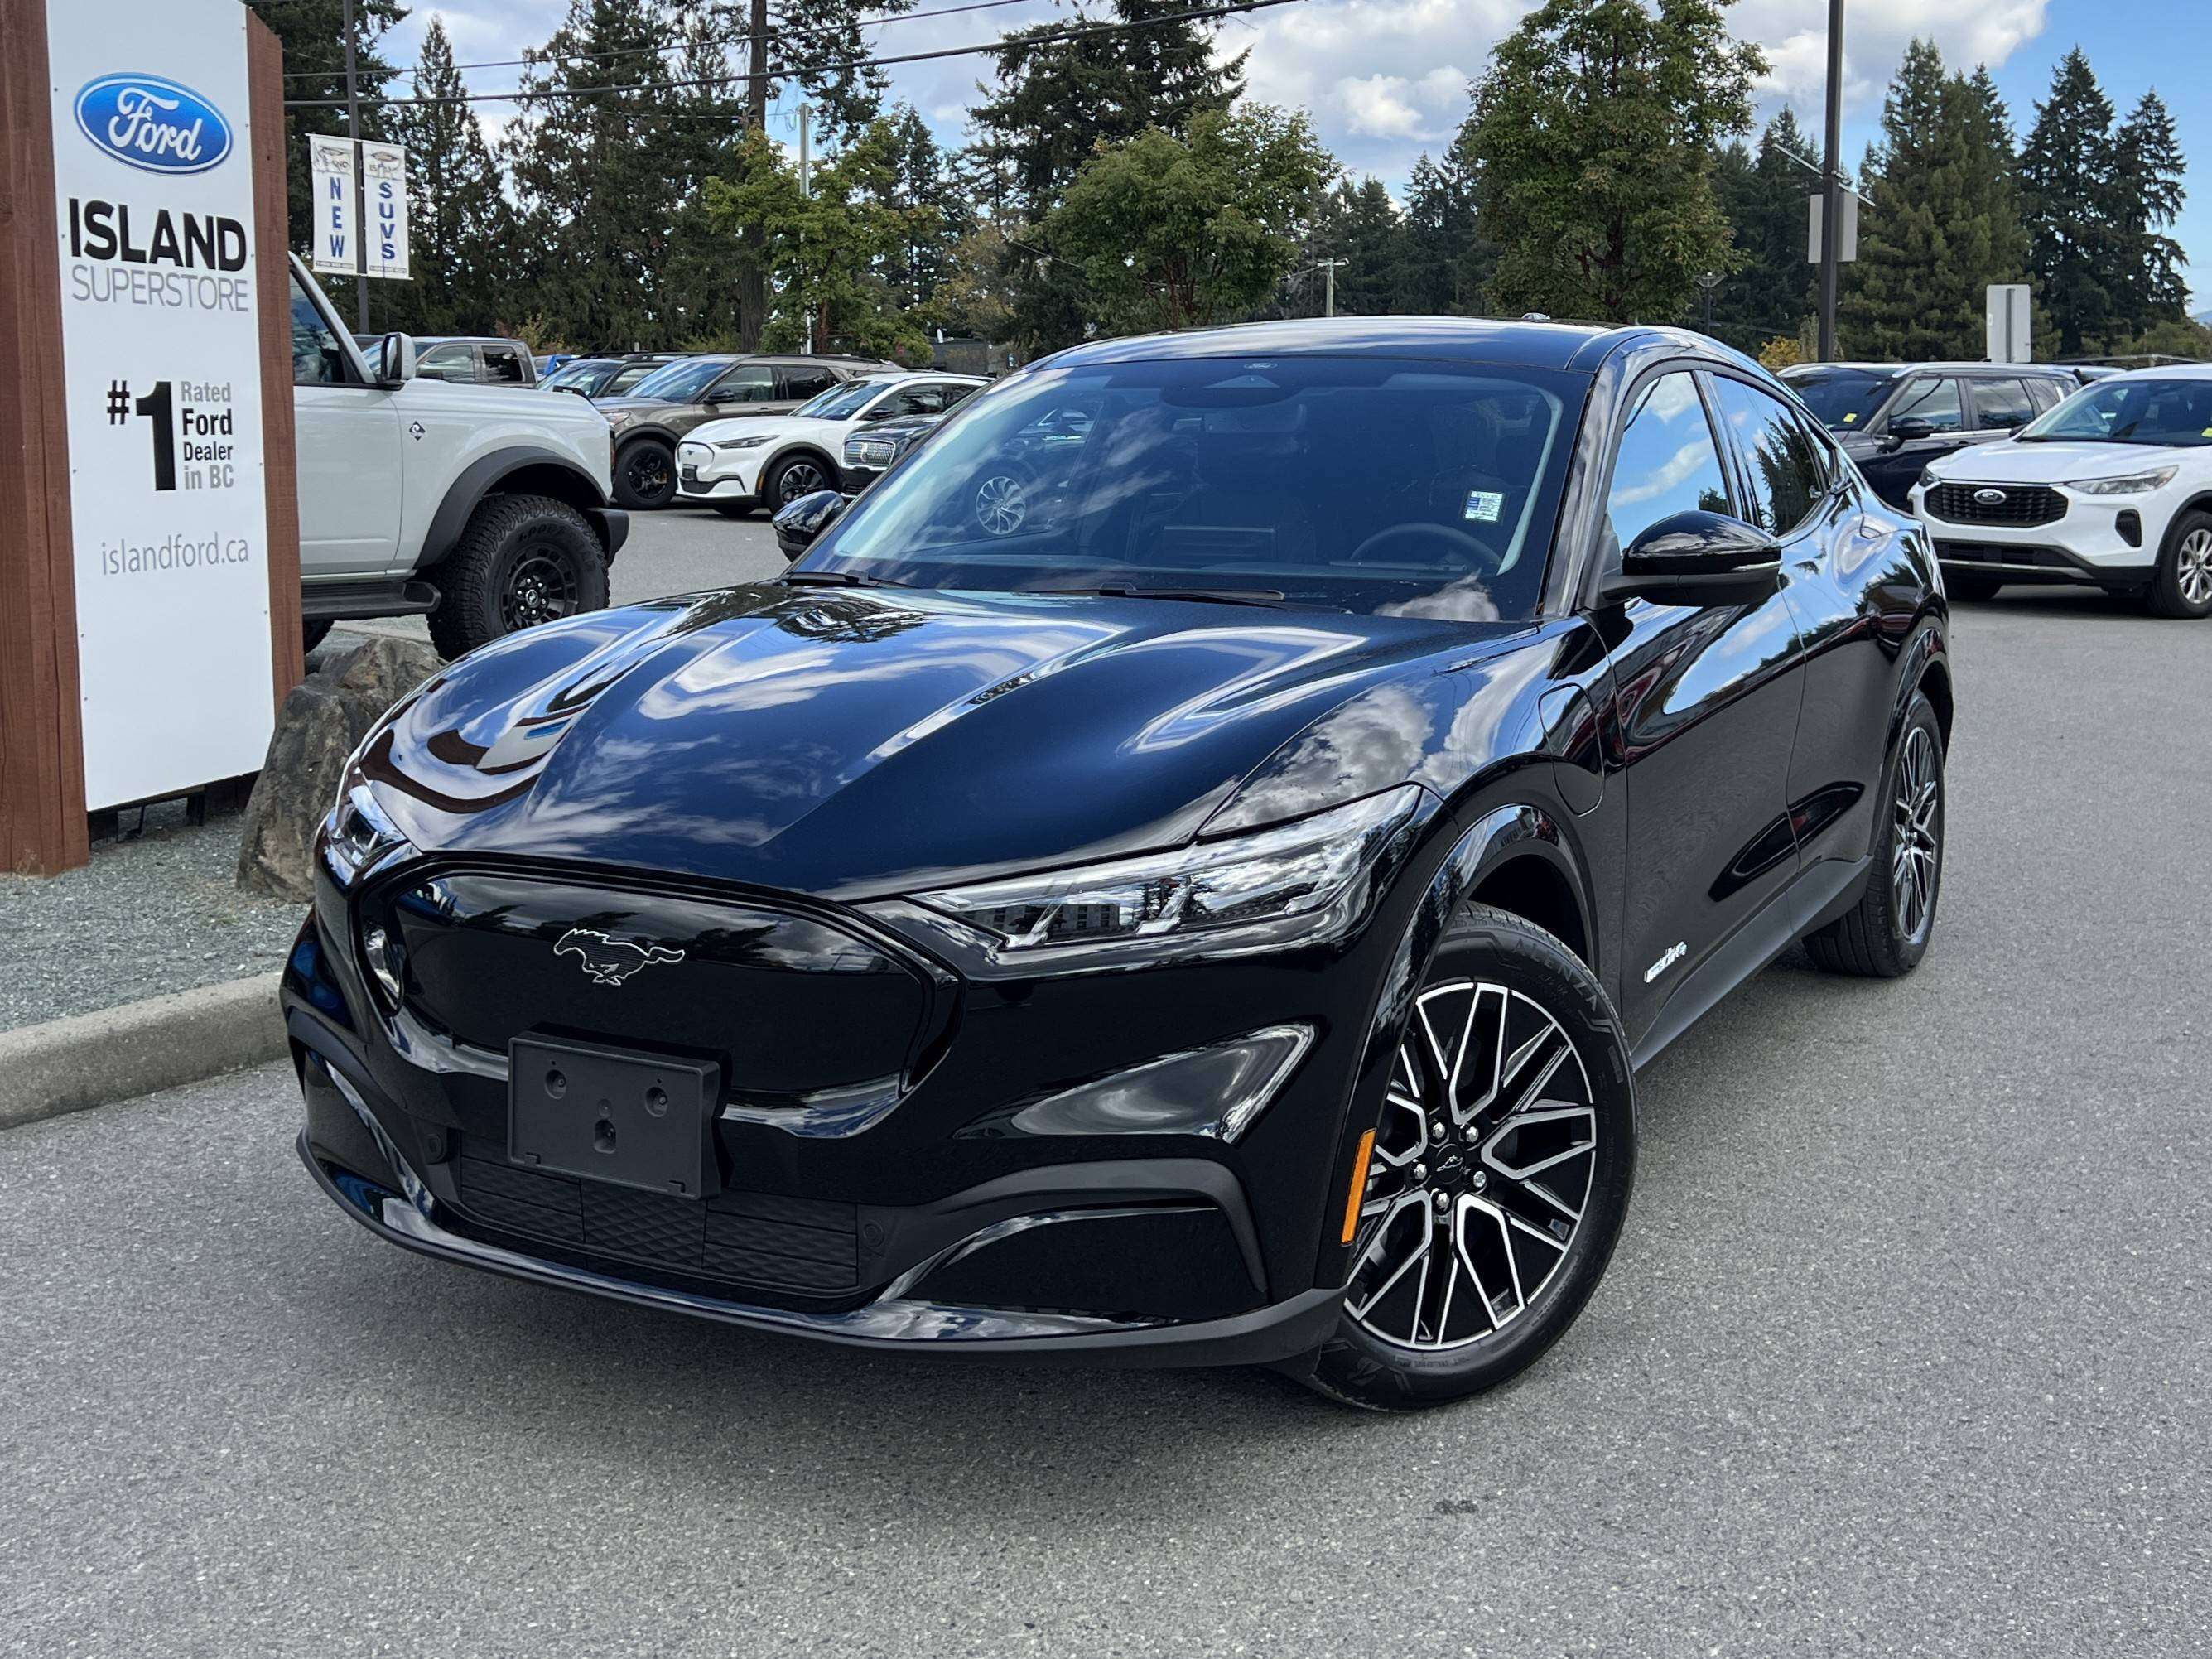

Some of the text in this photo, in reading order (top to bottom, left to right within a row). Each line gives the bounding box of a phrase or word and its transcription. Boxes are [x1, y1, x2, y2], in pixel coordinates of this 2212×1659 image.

[108, 87, 203, 161] Ford
[69, 198, 247, 272] ISLAND
[330, 176, 345, 258] NEW
[378, 181, 395, 259] SUVS
[71, 264, 248, 312] SUPERSTORE
[181, 381, 231, 403] Rated
[107, 380, 176, 491] #1
[182, 408, 233, 436] Ford
[183, 441, 234, 461] Dealer
[185, 465, 234, 490] in BC
[101, 532, 249, 576] islandford.ca
